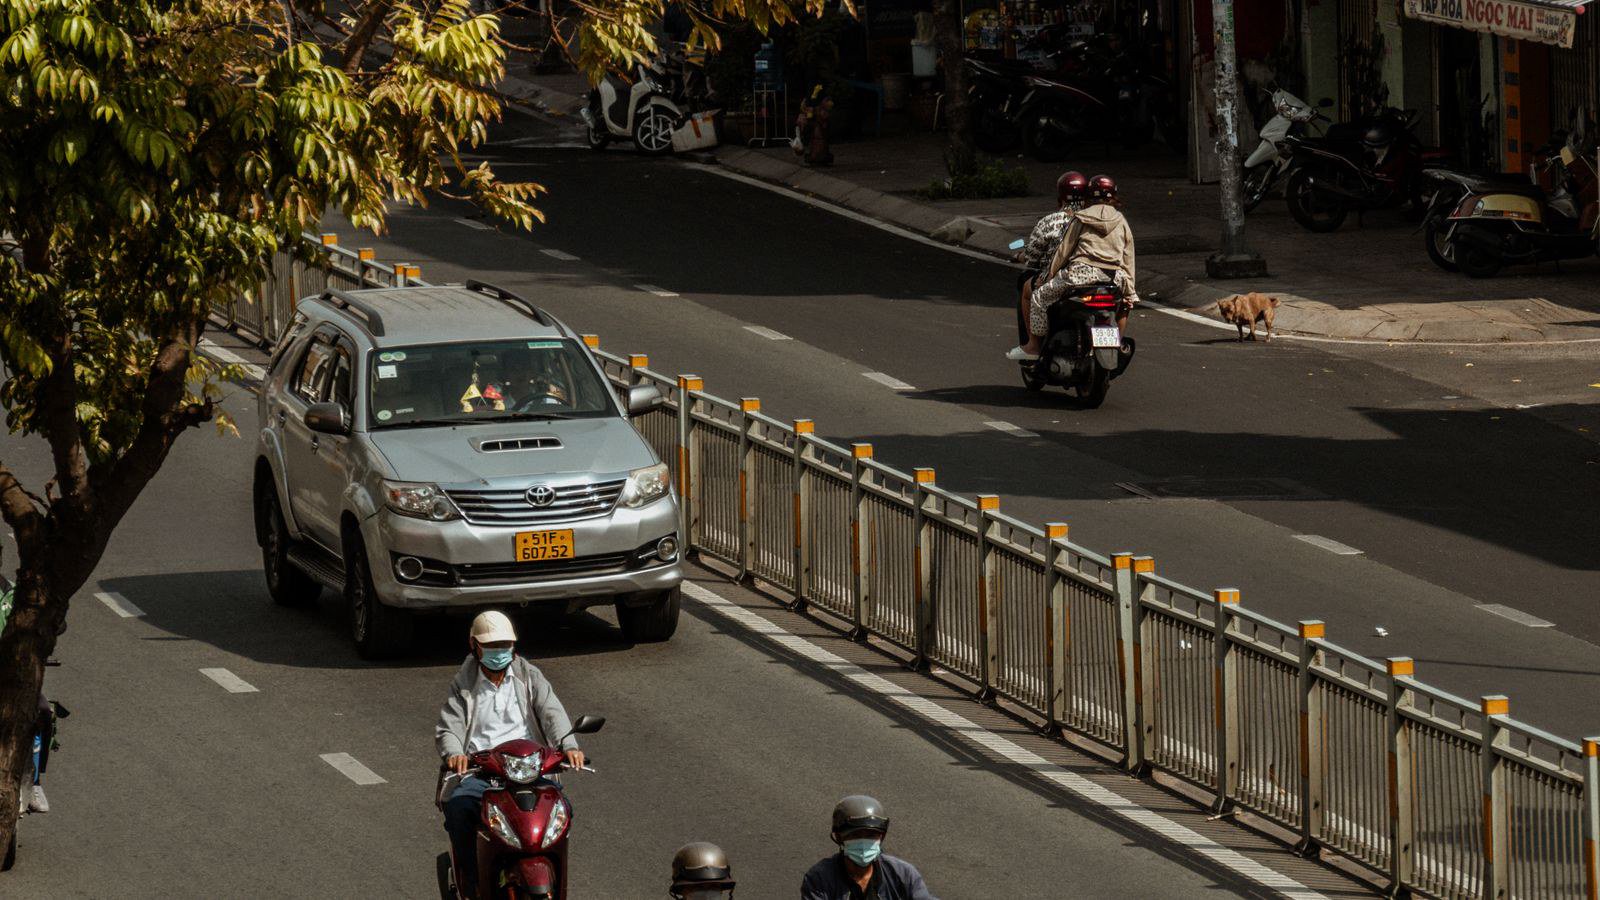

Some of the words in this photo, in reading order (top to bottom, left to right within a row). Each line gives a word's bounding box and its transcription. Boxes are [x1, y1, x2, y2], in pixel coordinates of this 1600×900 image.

[1507, 8, 1534, 31] MAI
[532, 532, 557, 545] 51F
[522, 545, 568, 559] 607.52
